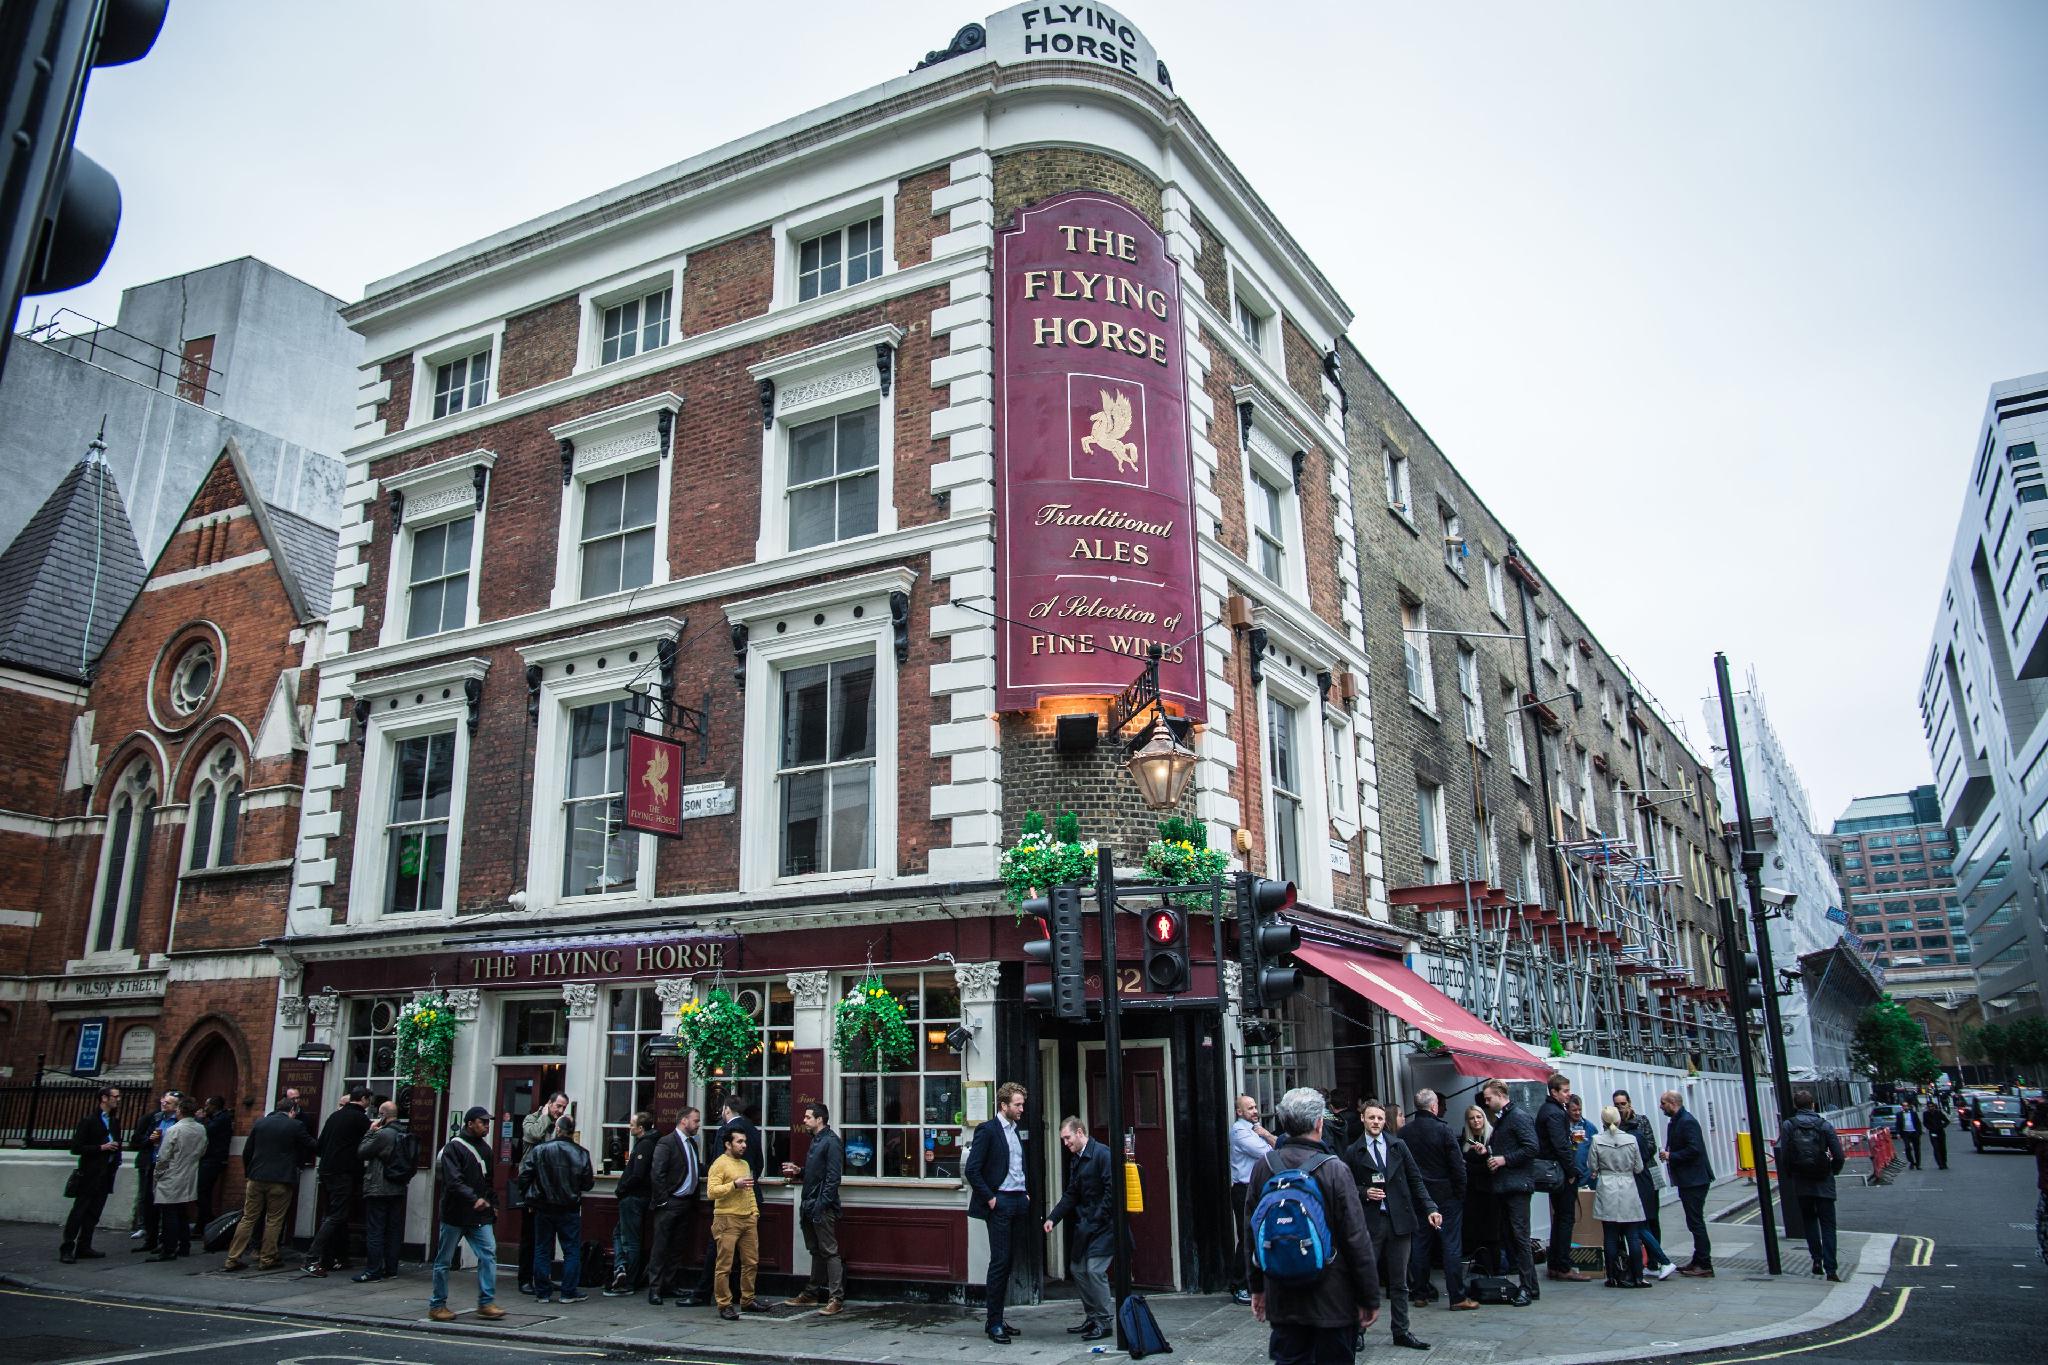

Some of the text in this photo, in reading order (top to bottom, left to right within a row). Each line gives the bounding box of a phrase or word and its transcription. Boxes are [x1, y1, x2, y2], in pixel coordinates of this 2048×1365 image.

[1022, 5, 1136, 49] FLYING
[1025, 33, 1138, 75] HORSE
[1059, 225, 1137, 262] THE
[1024, 270, 1167, 319] FLYING
[1033, 317, 1167, 365] HORSE
[1034, 503, 1174, 538] Traditional
[1069, 538, 1149, 565] ALES
[1028, 595, 1182, 632] A Selection of
[1031, 634, 1095, 656] FINE
[631, 809, 676, 826] FLYING HORSE
[648, 804, 661, 814] THE
[471, 943, 724, 979] THE FLYING HORSE
[75, 978, 160, 995] WILSON STREET
[663, 1082, 679, 1090] GOLF
[664, 1071, 679, 1080] PGA
[657, 1091, 684, 1099] MACHINE
